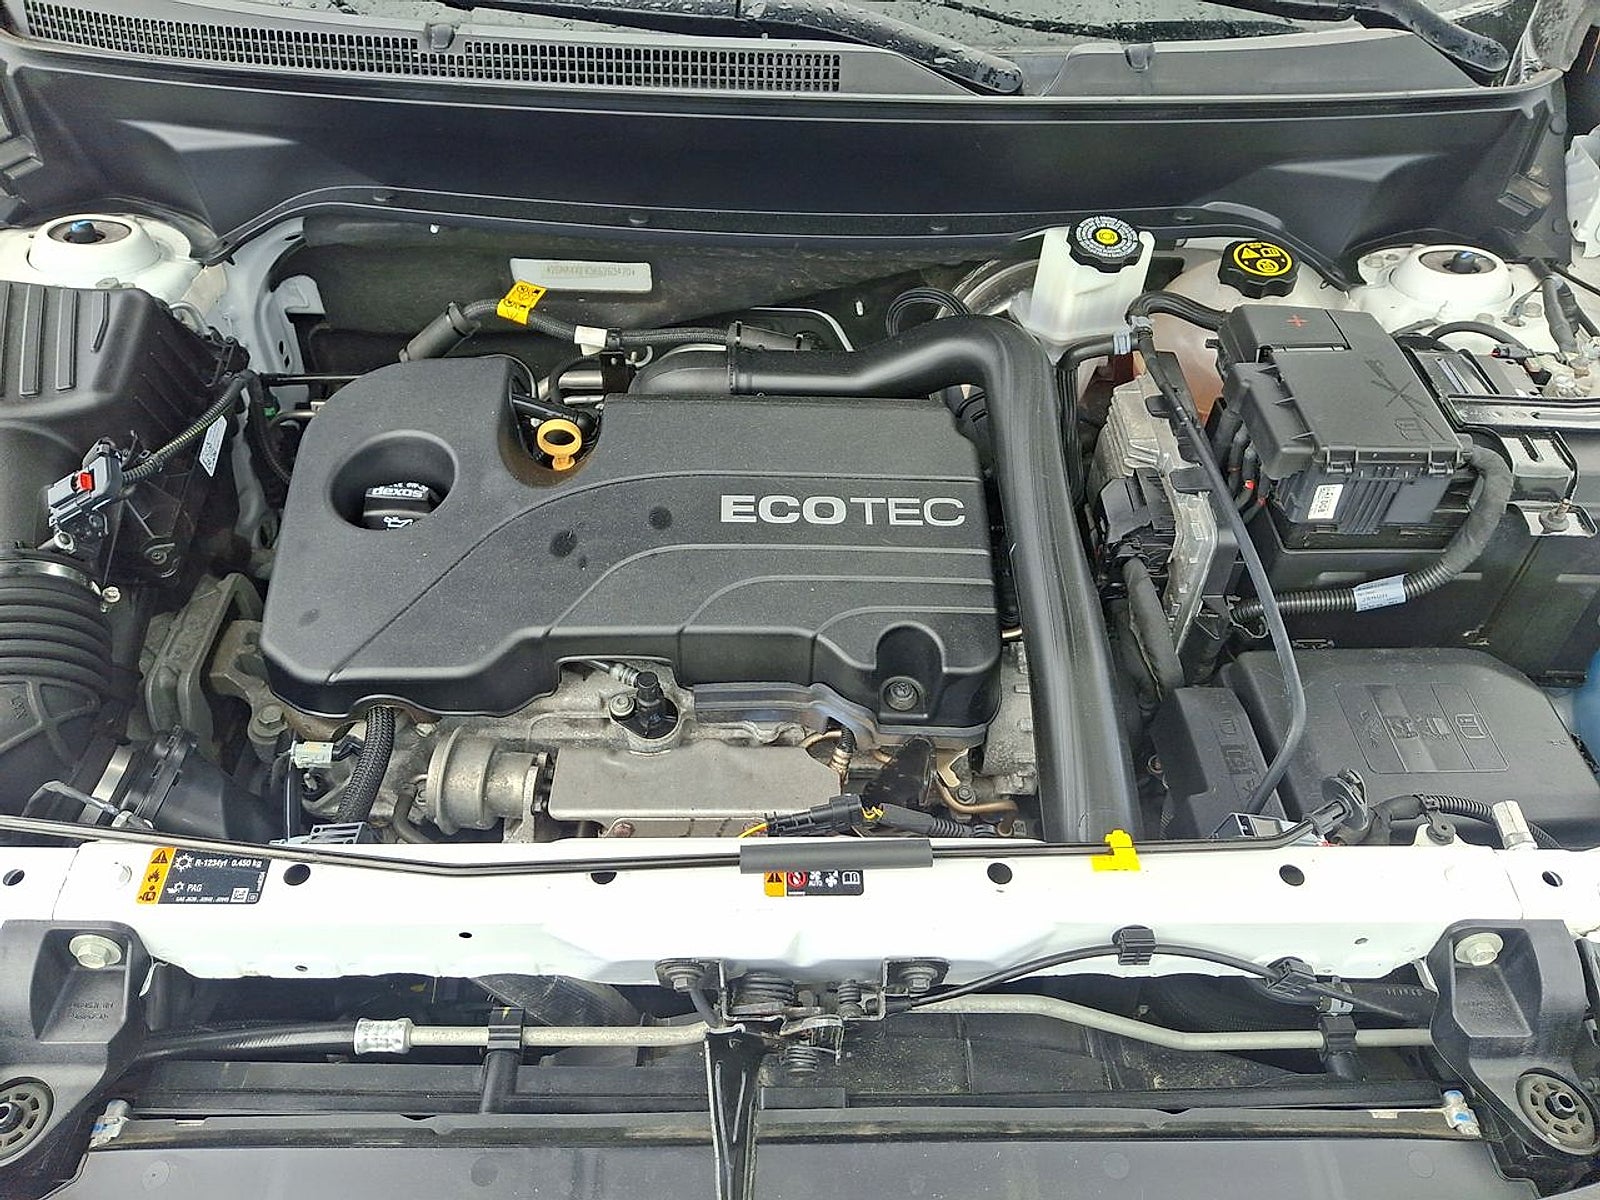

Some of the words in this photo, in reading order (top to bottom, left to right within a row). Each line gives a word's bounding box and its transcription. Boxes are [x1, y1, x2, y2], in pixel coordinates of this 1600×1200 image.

[372, 486, 423, 498] dexos
[720, 494, 966, 527] ECOTEC
[187, 884, 202, 892] PAG
